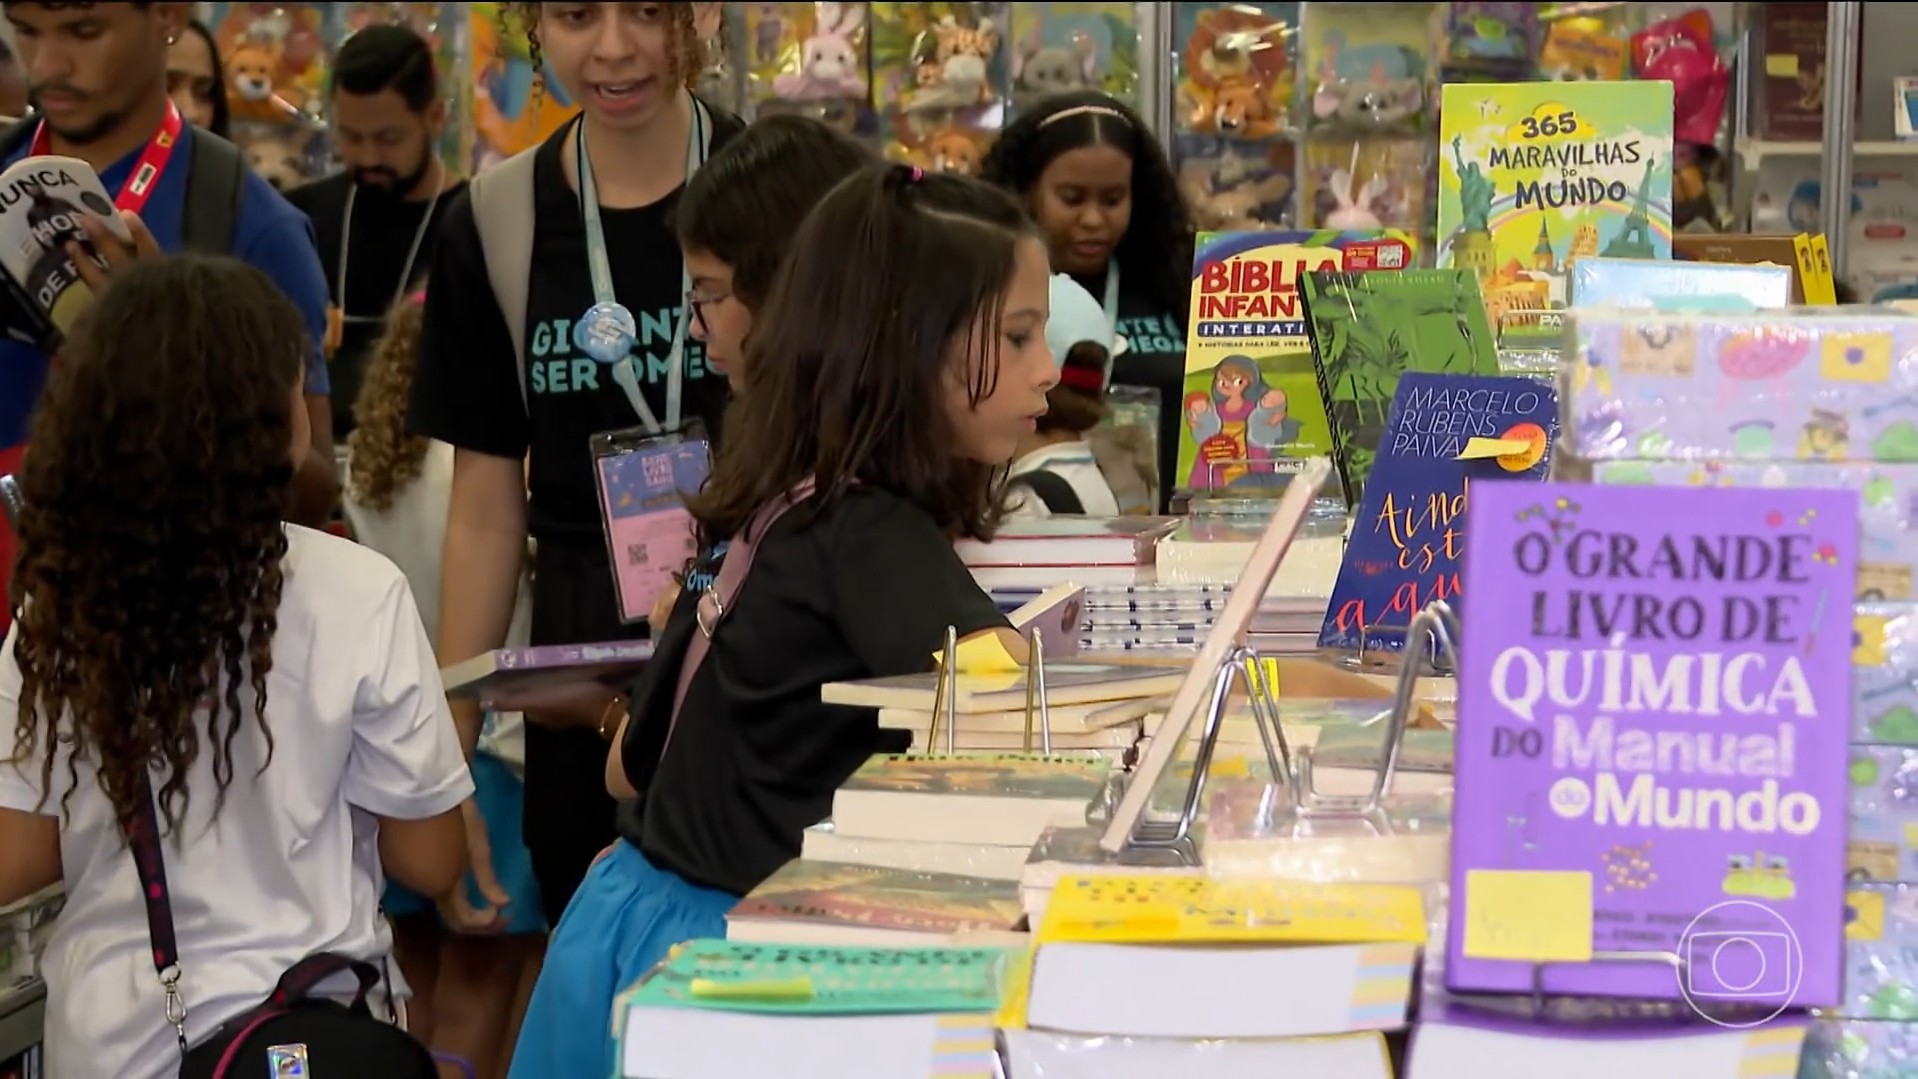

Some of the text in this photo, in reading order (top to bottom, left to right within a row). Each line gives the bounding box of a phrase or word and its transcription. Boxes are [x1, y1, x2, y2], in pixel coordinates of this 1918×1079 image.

[1521, 111, 1577, 139] 365
[1489, 140, 1640, 170] MARAVILHAS
[1561, 168, 1578, 178] DO
[0, 168, 80, 215] UNCA
[1515, 177, 1627, 211] MUNDO
[1199, 294, 1300, 319] INFAN
[1540, 314, 1563, 326] PA
[1203, 323, 1305, 335] INTERATI
[532, 357, 600, 394] SER
[1405, 386, 1539, 415] MARCELO
[1399, 409, 1497, 436] RUBENS
[1391, 432, 1461, 458] PAIVA
[1375, 476, 1470, 548] Aind
[1399, 528, 1465, 575] est
[1513, 529, 1813, 584] O GRANDE
[1330, 571, 1463, 634] aqu
[1531, 589, 1800, 644] LIVRO DE
[1490, 631, 1818, 722] QUÍMICA
[1490, 725, 1543, 758] DO
[1552, 714, 1795, 778] Manual
[1593, 772, 1821, 835] Mundo
